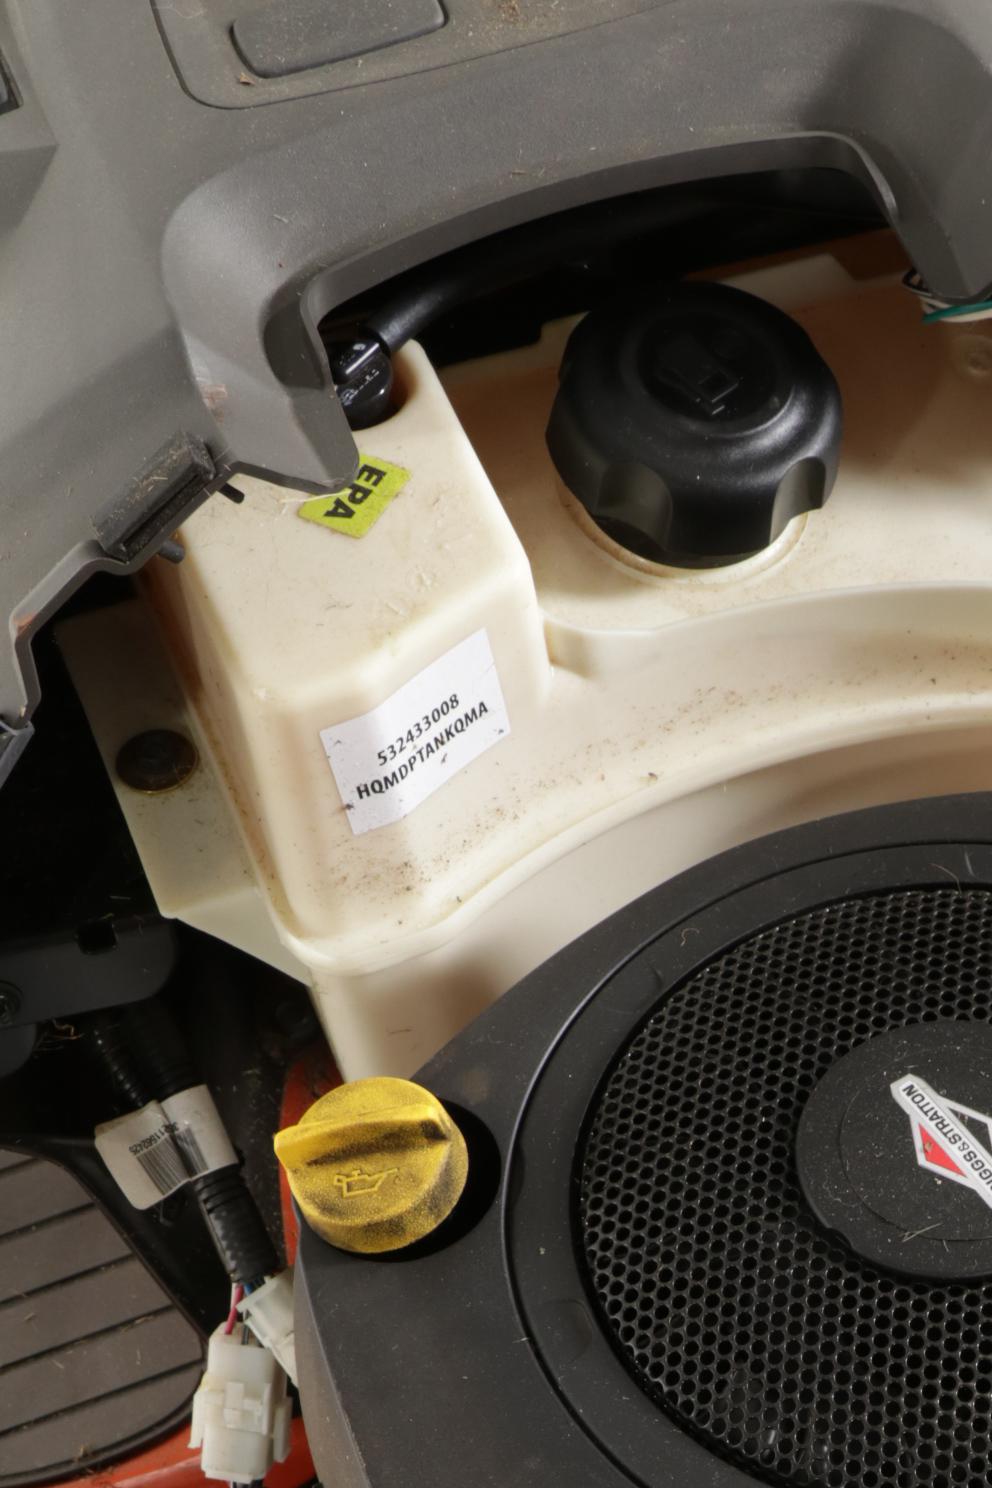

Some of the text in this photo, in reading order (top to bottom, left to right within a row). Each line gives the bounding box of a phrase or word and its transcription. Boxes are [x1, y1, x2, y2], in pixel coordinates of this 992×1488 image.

[323, 464, 388, 519] EPA
[356, 700, 489, 800] HQMDPTANKQMA
[376, 693, 460, 767] 532433008
